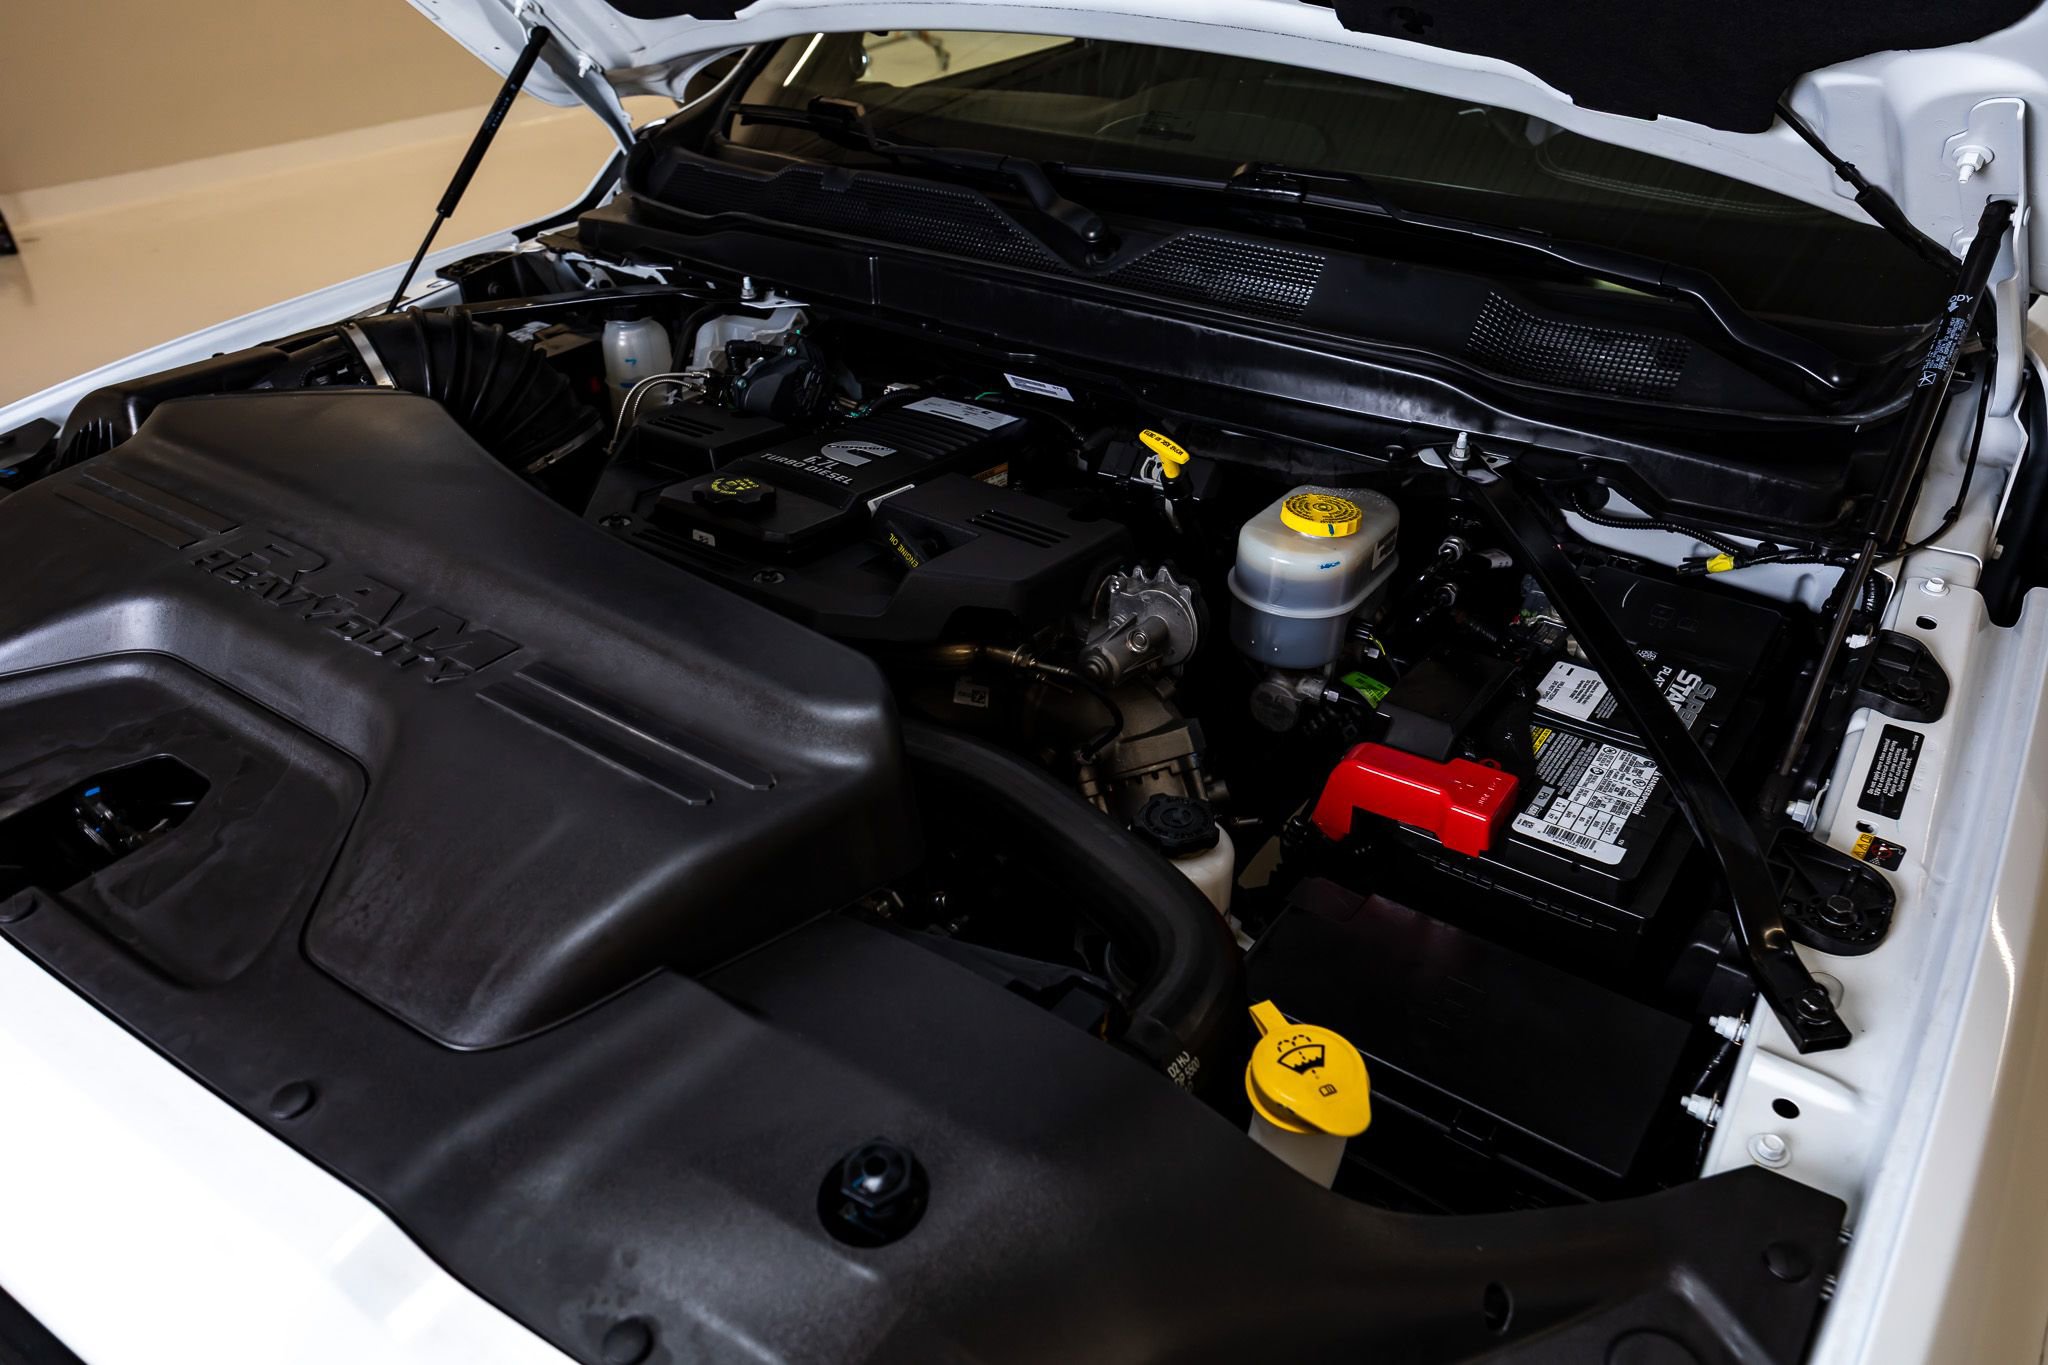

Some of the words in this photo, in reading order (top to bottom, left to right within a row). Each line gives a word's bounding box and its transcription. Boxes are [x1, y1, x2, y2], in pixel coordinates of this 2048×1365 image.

[1948, 294, 1973, 303] ODY
[760, 453, 806, 468] TURBO
[804, 465, 854, 485] DIESEL
[803, 455, 840, 470] 6.7L
[889, 532, 899, 546] OIL
[897, 544, 919, 568] ENGINE
[217, 529, 523, 673] RAM
[190, 549, 342, 621] HEAVY
[322, 614, 469, 684] DUTY
[1665, 669, 1702, 713] STA
